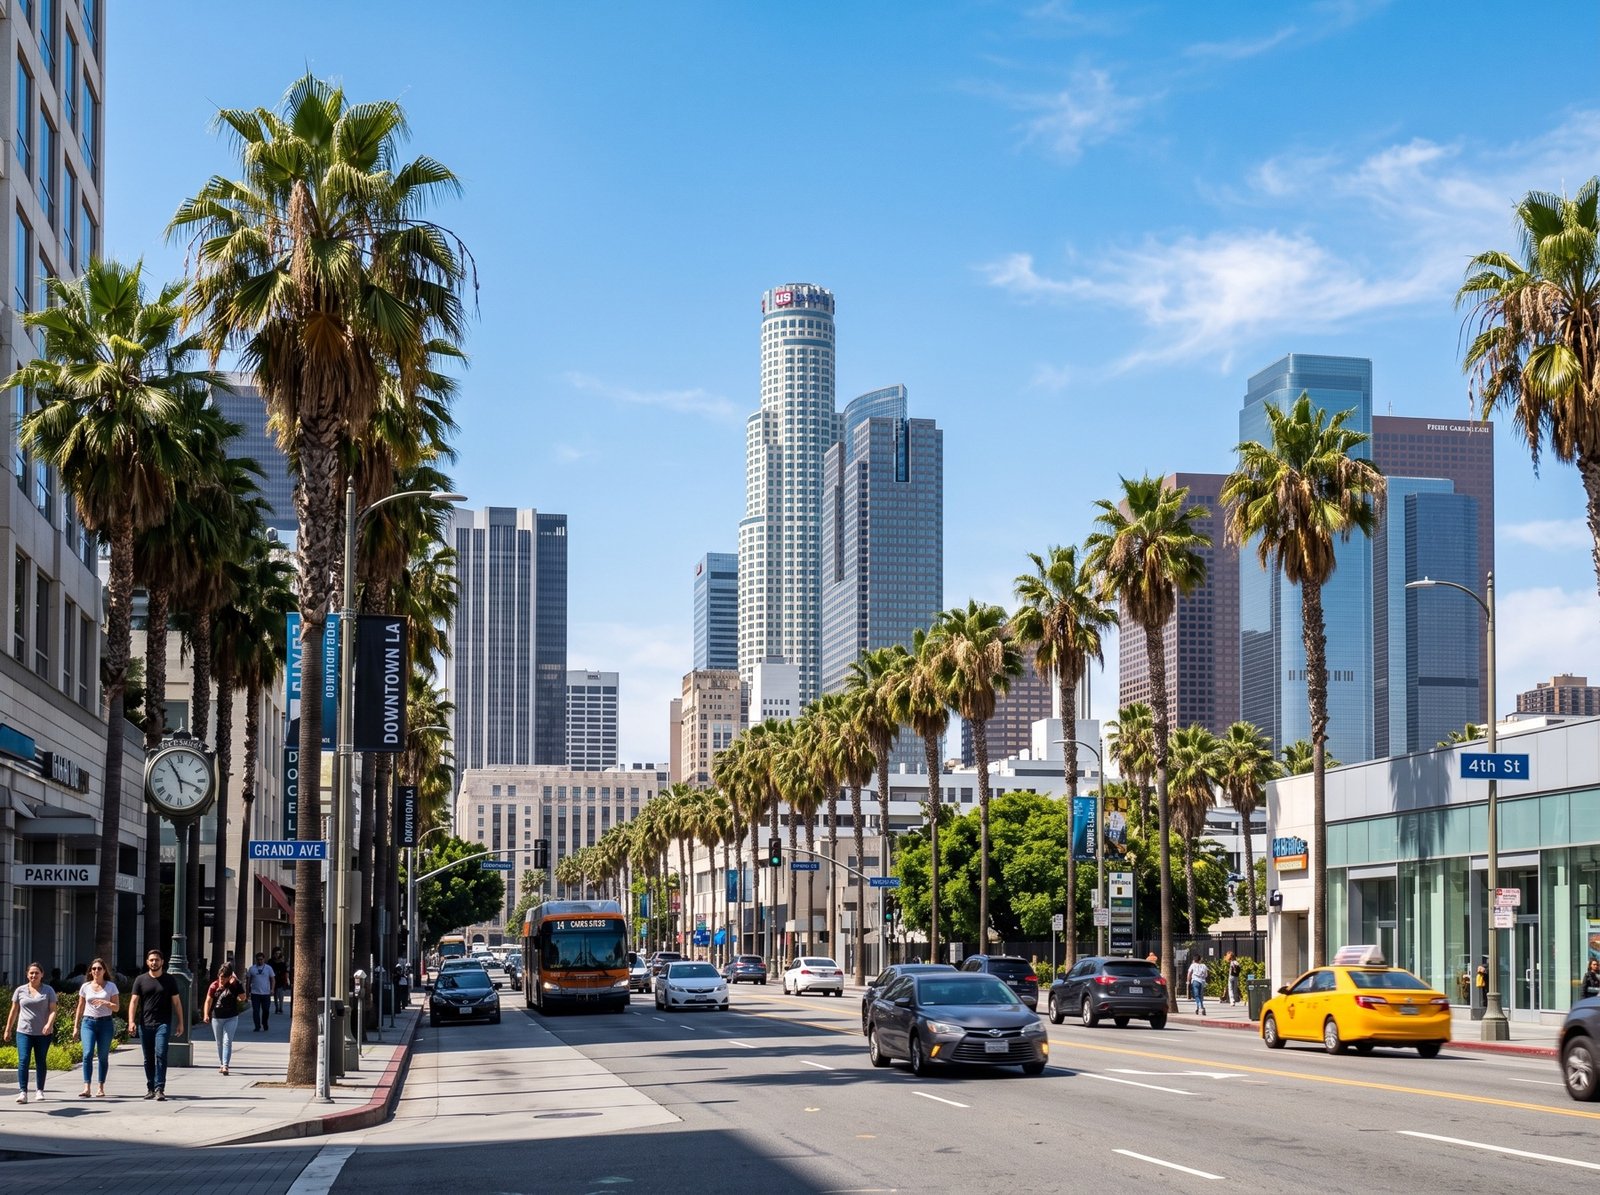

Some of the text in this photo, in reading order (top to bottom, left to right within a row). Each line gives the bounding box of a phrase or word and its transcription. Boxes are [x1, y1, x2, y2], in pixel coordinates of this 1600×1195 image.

[384, 623, 400, 744] DOWNTOWN LA
[1468, 759, 1520, 773] 4th St
[287, 751, 298, 841] DOCEL
[254, 844, 321, 857] GRAND AVE
[25, 868, 89, 882] PARKING
[556, 921, 565, 930] 14
